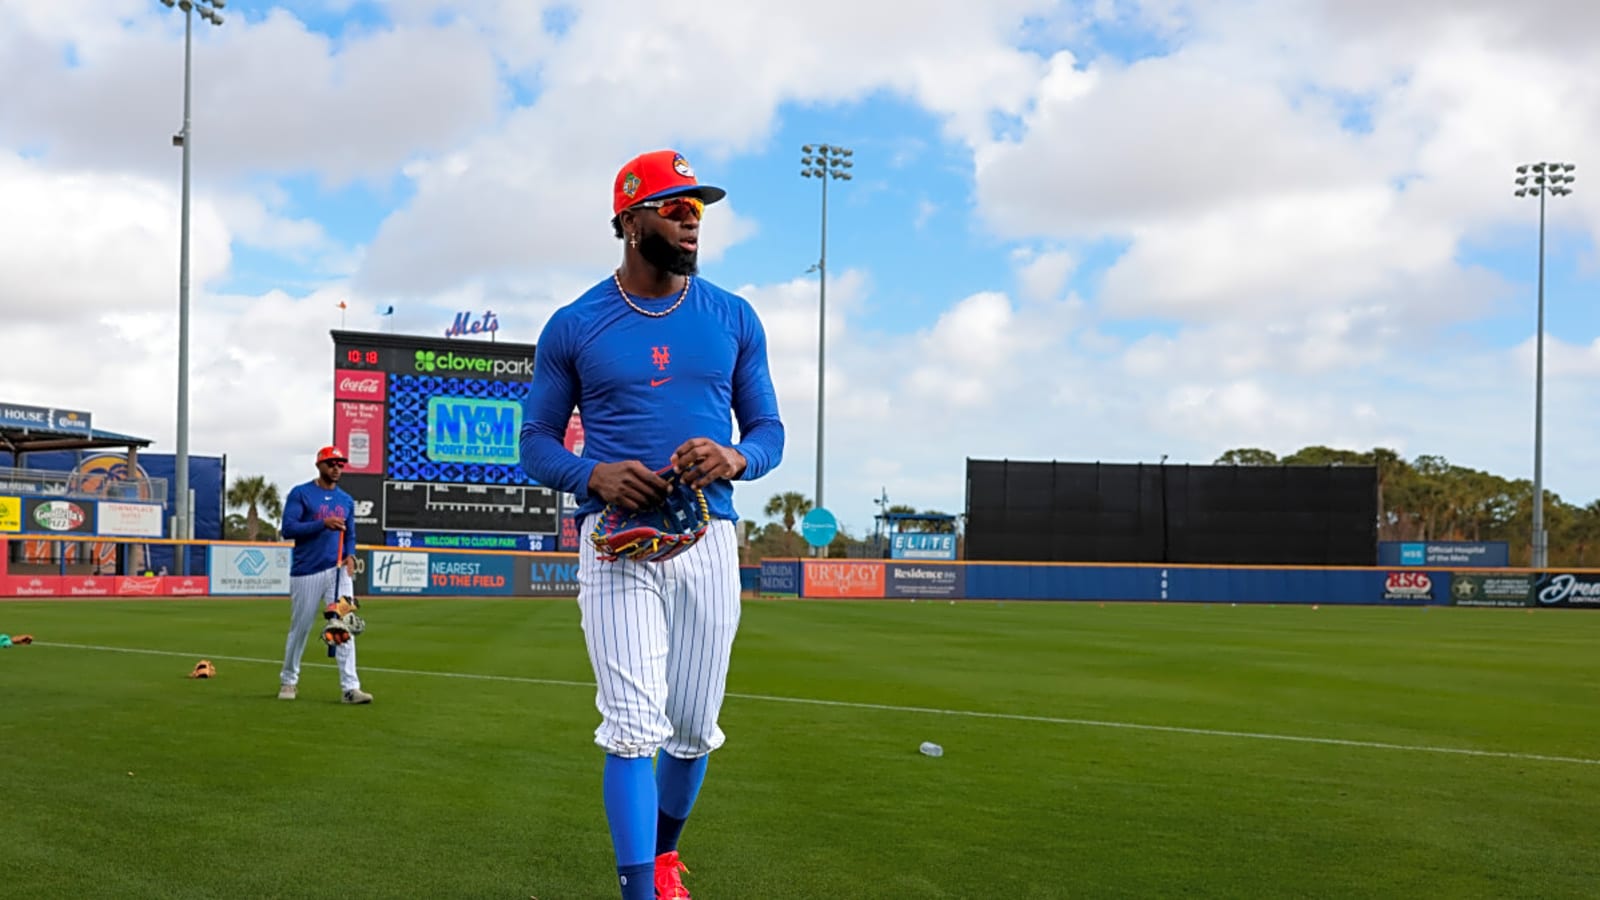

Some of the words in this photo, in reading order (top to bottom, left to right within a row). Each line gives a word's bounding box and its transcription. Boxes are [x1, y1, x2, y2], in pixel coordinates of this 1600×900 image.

[445, 310, 499, 336] Mets
[4, 408, 45, 423] HOUSE
[436, 403, 515, 446] NYM
[435, 445, 464, 455] PORT
[424, 536, 460, 547] WELCOME
[461, 537, 470, 546] TO
[471, 537, 497, 547] CLOVER
[498, 538, 516, 548] PARK
[895, 536, 951, 549] ELITE
[1454, 546, 1486, 554] Hospital
[431, 562, 481, 575] NEAREST
[894, 567, 943, 579] Residence
[431, 575, 447, 587] TO
[449, 575, 471, 587] THE
[473, 575, 505, 588] FIELD
[1388, 571, 1428, 588] RSG
